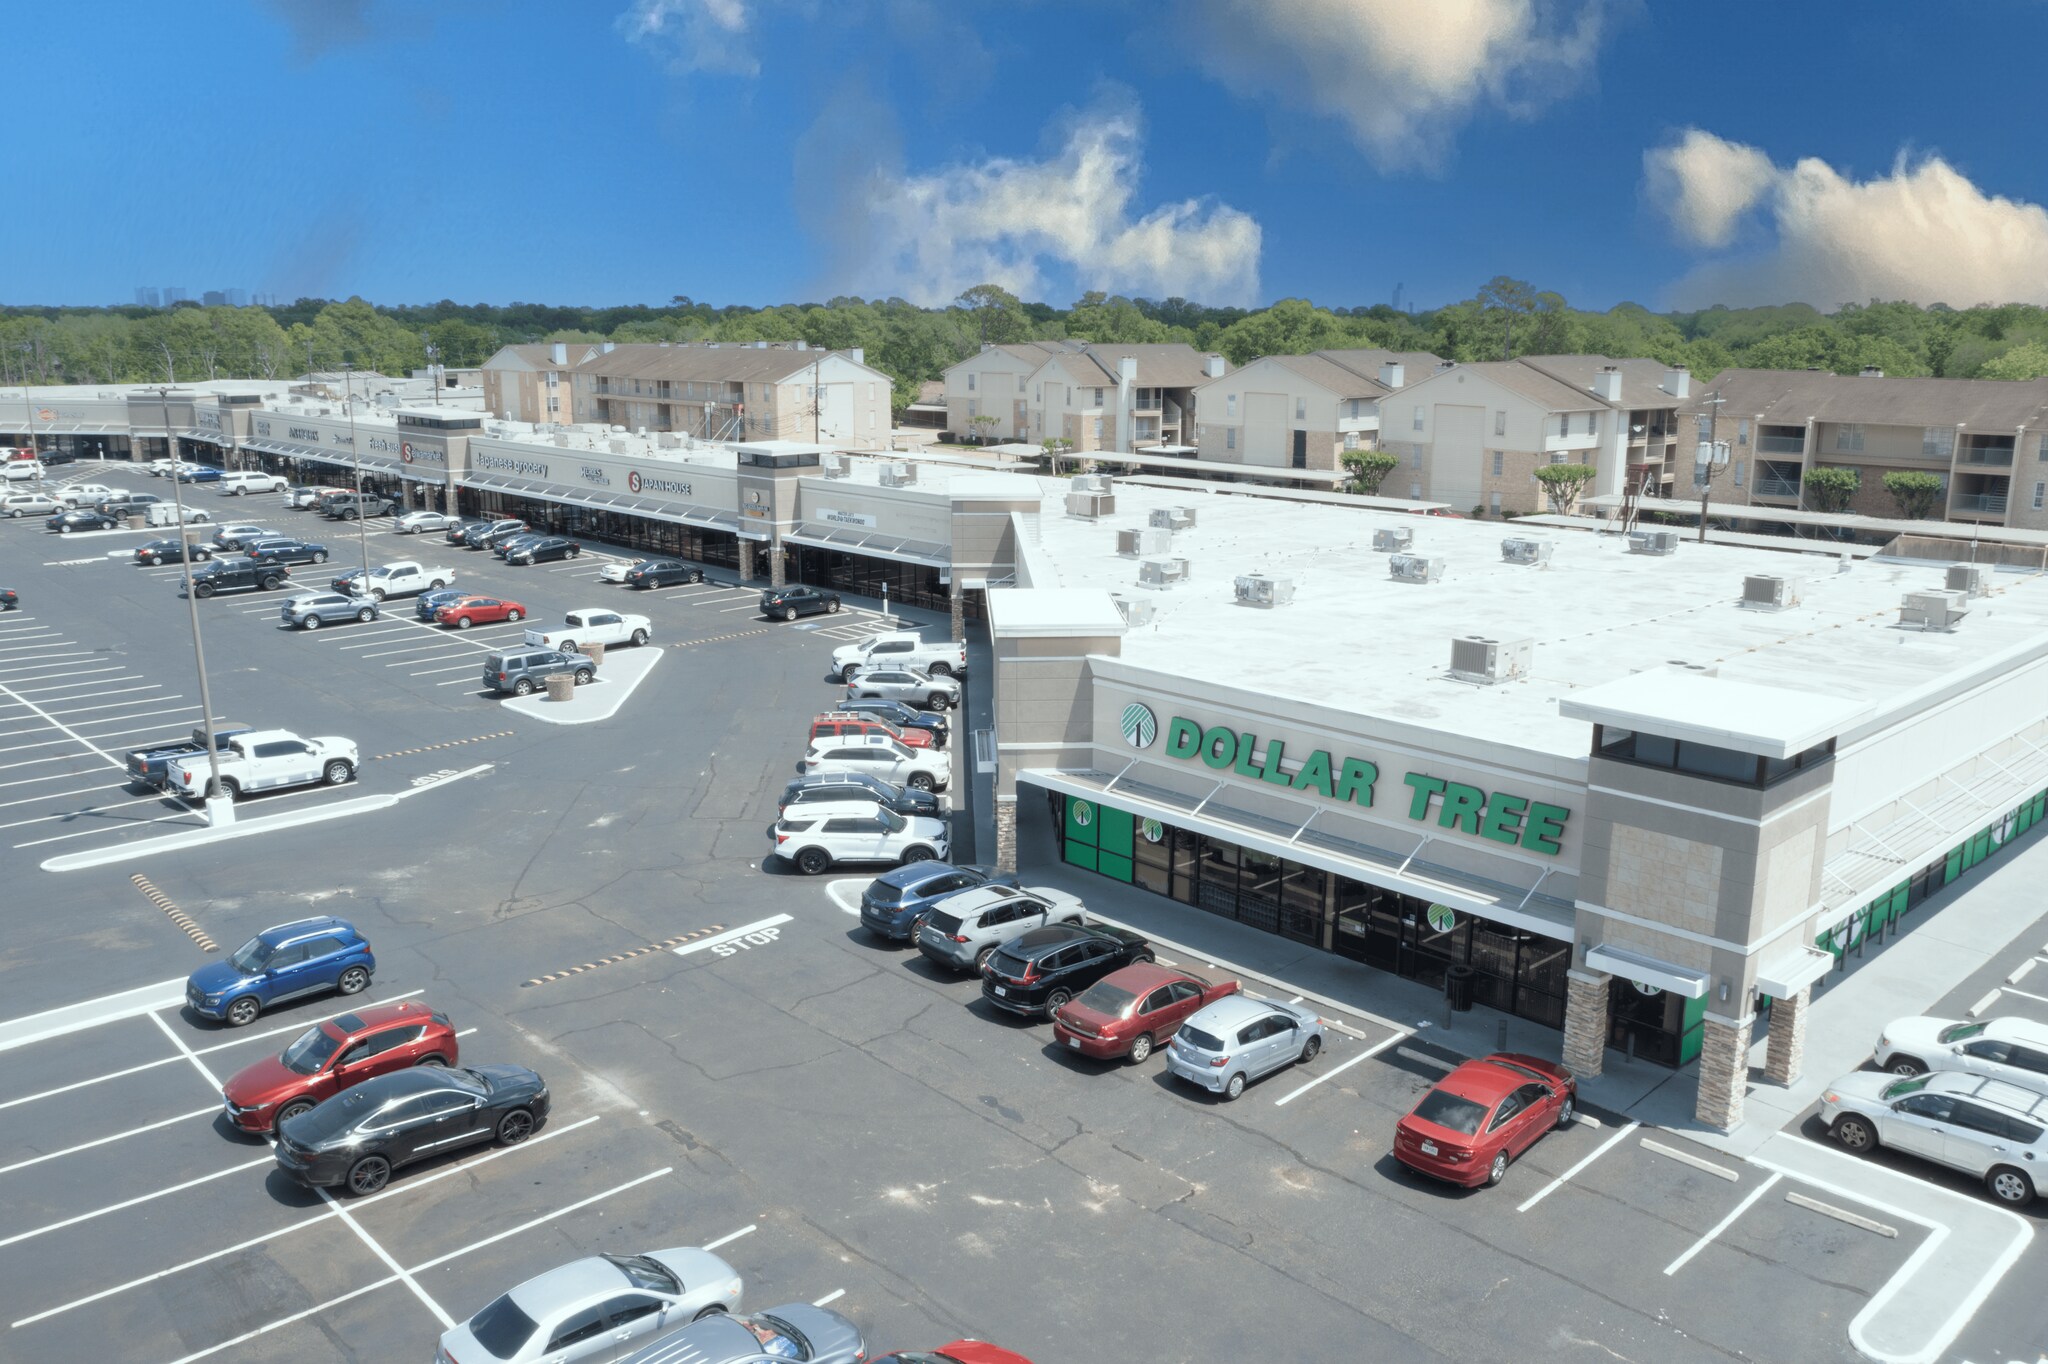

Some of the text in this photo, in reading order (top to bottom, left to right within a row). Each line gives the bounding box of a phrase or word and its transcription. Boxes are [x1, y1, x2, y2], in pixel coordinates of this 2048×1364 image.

[476, 452, 548, 478] Japanese grocery
[640, 479, 665, 491] JAPAN
[665, 482, 691, 495] HOUSE
[1166, 716, 1379, 807] DOLLAR
[1404, 772, 1570, 855] TREE
[711, 927, 780, 957] STOP
